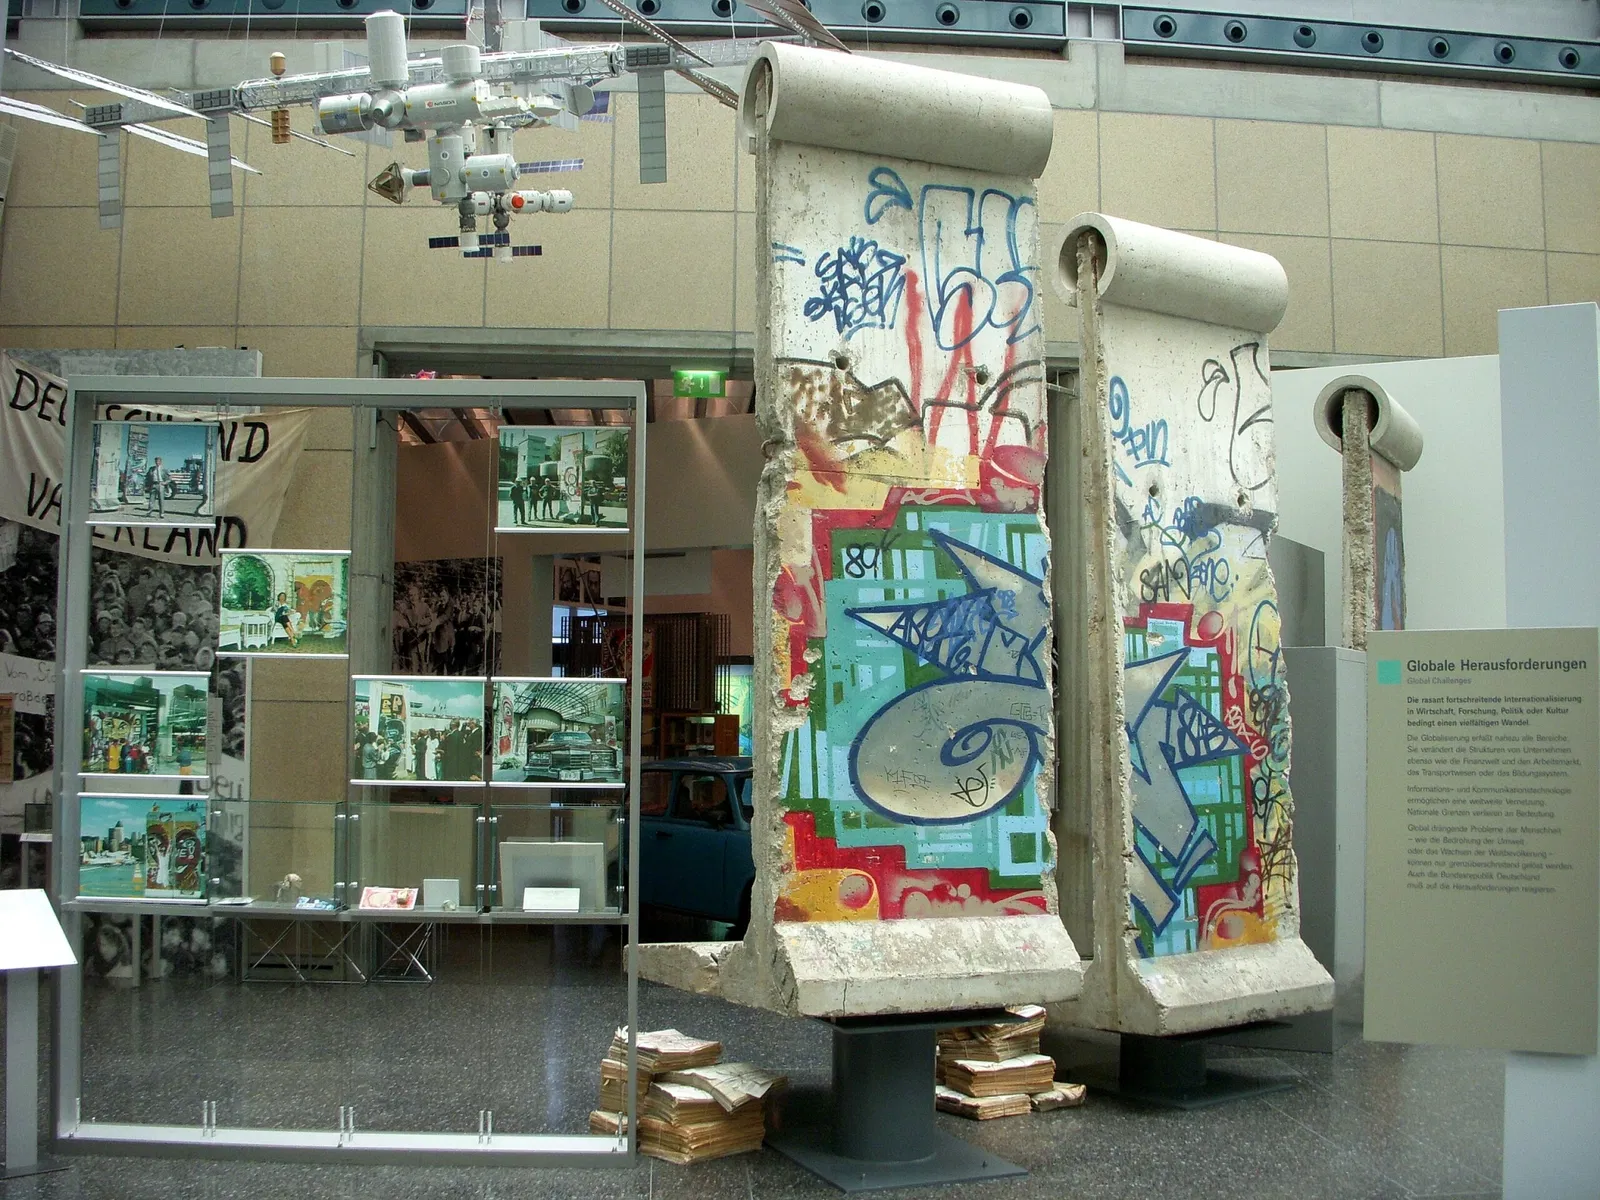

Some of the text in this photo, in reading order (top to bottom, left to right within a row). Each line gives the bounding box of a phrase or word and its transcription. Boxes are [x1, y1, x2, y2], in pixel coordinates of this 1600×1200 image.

[1407, 658, 1587, 672] Globale Herausforderungen
[1432, 677, 1472, 685] Challenges
[1504, 696, 1582, 704] Internationalisierung
[1417, 708, 1456, 716] Wirtschaft,
[1460, 719, 1499, 727] vielfältigen
